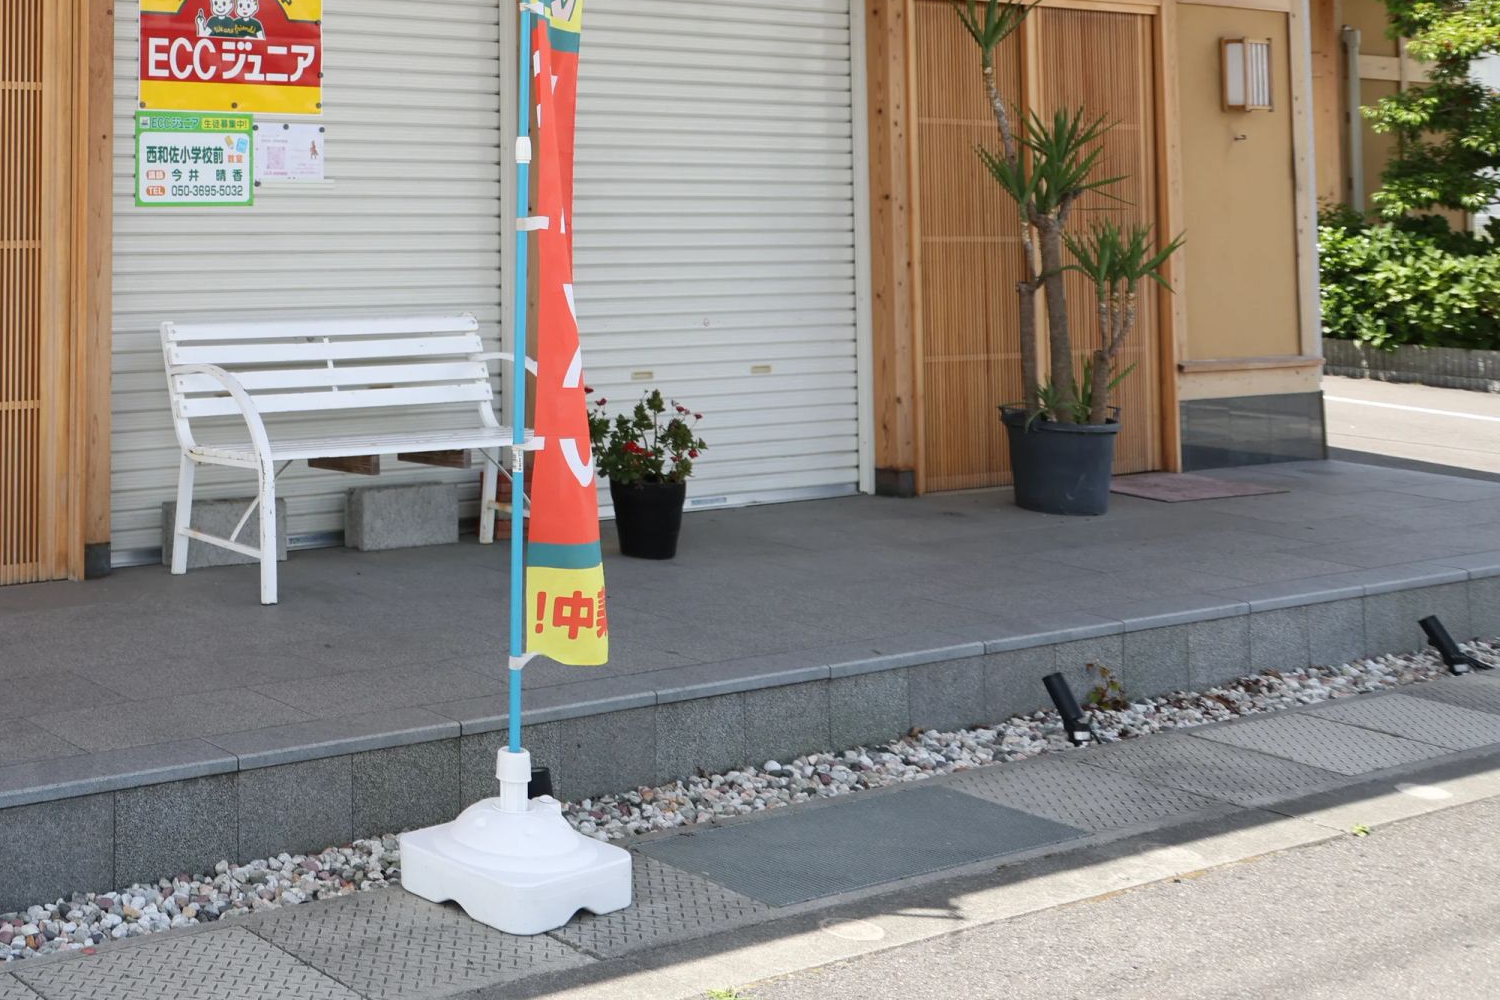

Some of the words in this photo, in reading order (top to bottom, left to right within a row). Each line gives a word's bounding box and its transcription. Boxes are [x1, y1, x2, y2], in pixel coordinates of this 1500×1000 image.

[148, 37, 315, 82] ECCジュニア
[151, 117, 199, 129] ECCジュニア
[204, 118, 247, 129] 生徒募集中!
[146, 145, 224, 164] 西和佐小学校前
[148, 187, 163, 196] TEL
[171, 185, 243, 196] 050-3695-5032
